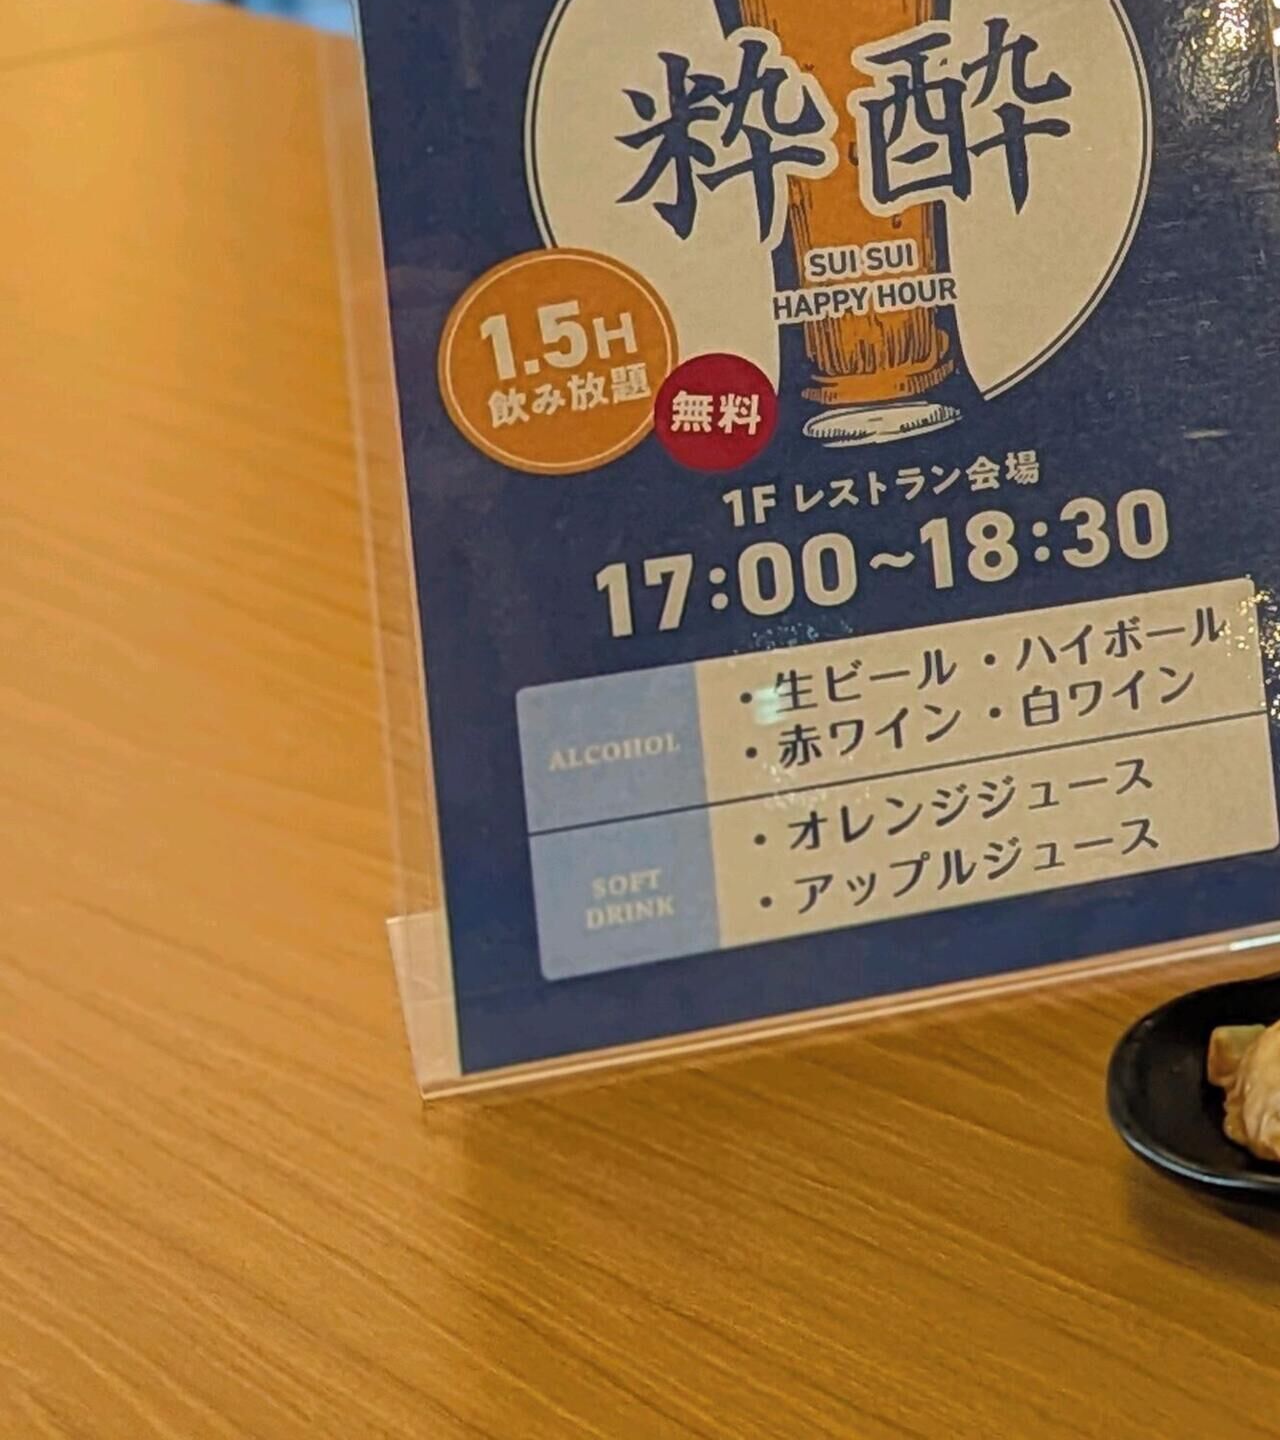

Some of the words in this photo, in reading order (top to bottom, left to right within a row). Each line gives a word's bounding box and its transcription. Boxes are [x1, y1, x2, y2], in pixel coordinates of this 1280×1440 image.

[616, 18, 1071, 242] 粋酔
[809, 250, 857, 277] SUI
[867, 244, 913, 271] SUI
[773, 287, 868, 320] HAPPY
[878, 277, 957, 308] HOUR
[480, 301, 637, 379] 1.5H
[487, 362, 651, 428] 飲み放題
[671, 390, 761, 435] 無料
[723, 484, 777, 527] 1F
[795, 450, 1040, 513] レストラン会場
[549, 733, 681, 772] ALCOHOL
[592, 868, 662, 899] SOFT
[586, 895, 675, 930] DRINK
